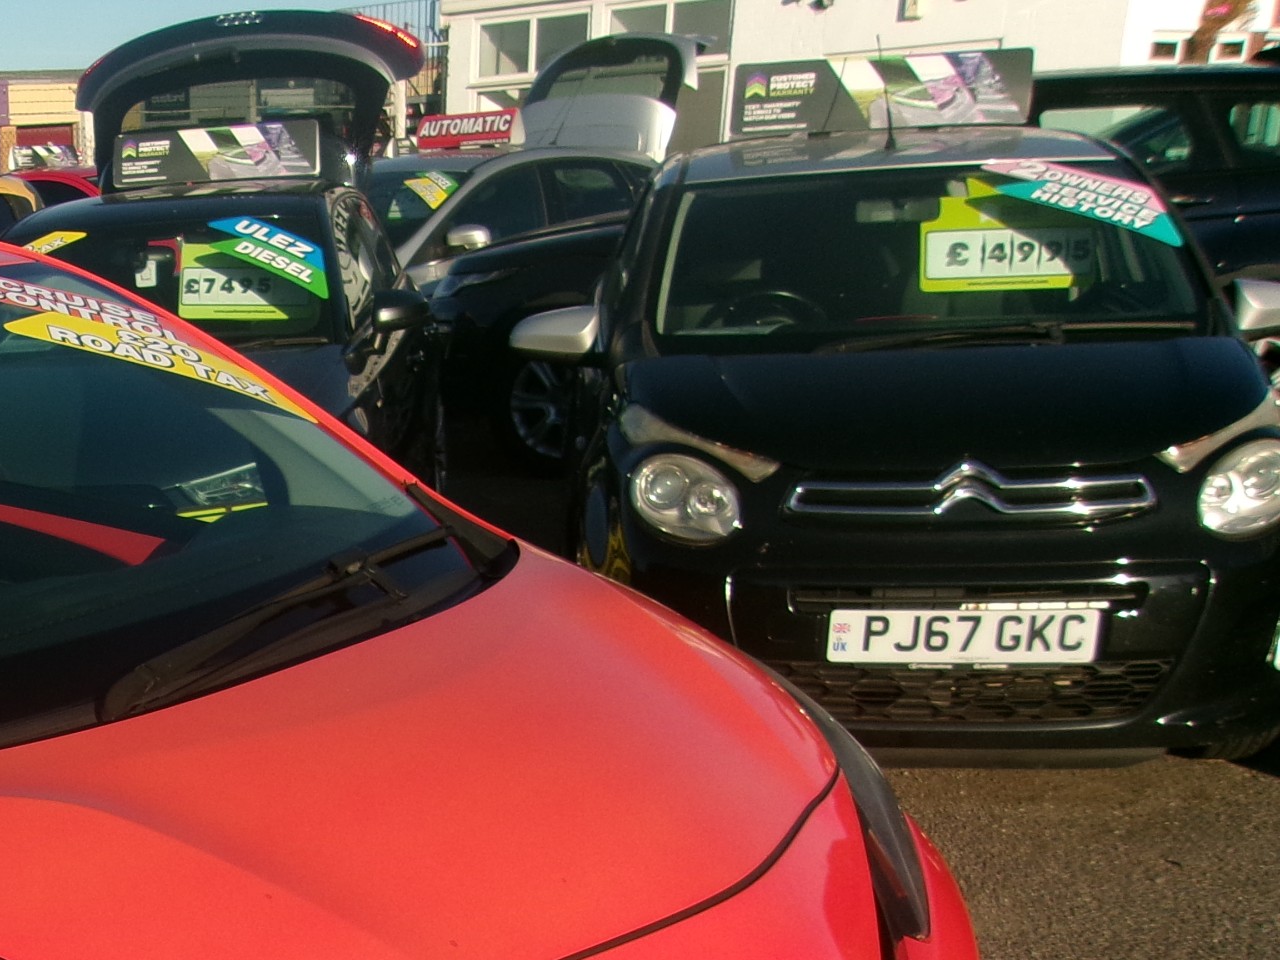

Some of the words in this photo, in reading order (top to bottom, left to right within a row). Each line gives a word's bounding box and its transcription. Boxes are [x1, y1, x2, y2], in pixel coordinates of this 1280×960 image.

[420, 114, 511, 137] AUTOMATIC
[1010, 161, 1048, 181] 2
[1048, 169, 1153, 206] OWNERS
[1041, 182, 1160, 221] SERVICE
[1030, 190, 1155, 230] HISTORY
[234, 220, 314, 259] ULEZ
[234, 240, 314, 283] DIESEL
[184, 277, 270, 295] £7495
[47, 325, 174, 369] ROAD
[183, 360, 277, 404] TAX
[116, 329, 202, 363] £20
[832, 641, 847, 652] UK
[862, 614, 983, 653] PJ67
[994, 614, 1087, 653] GKC
